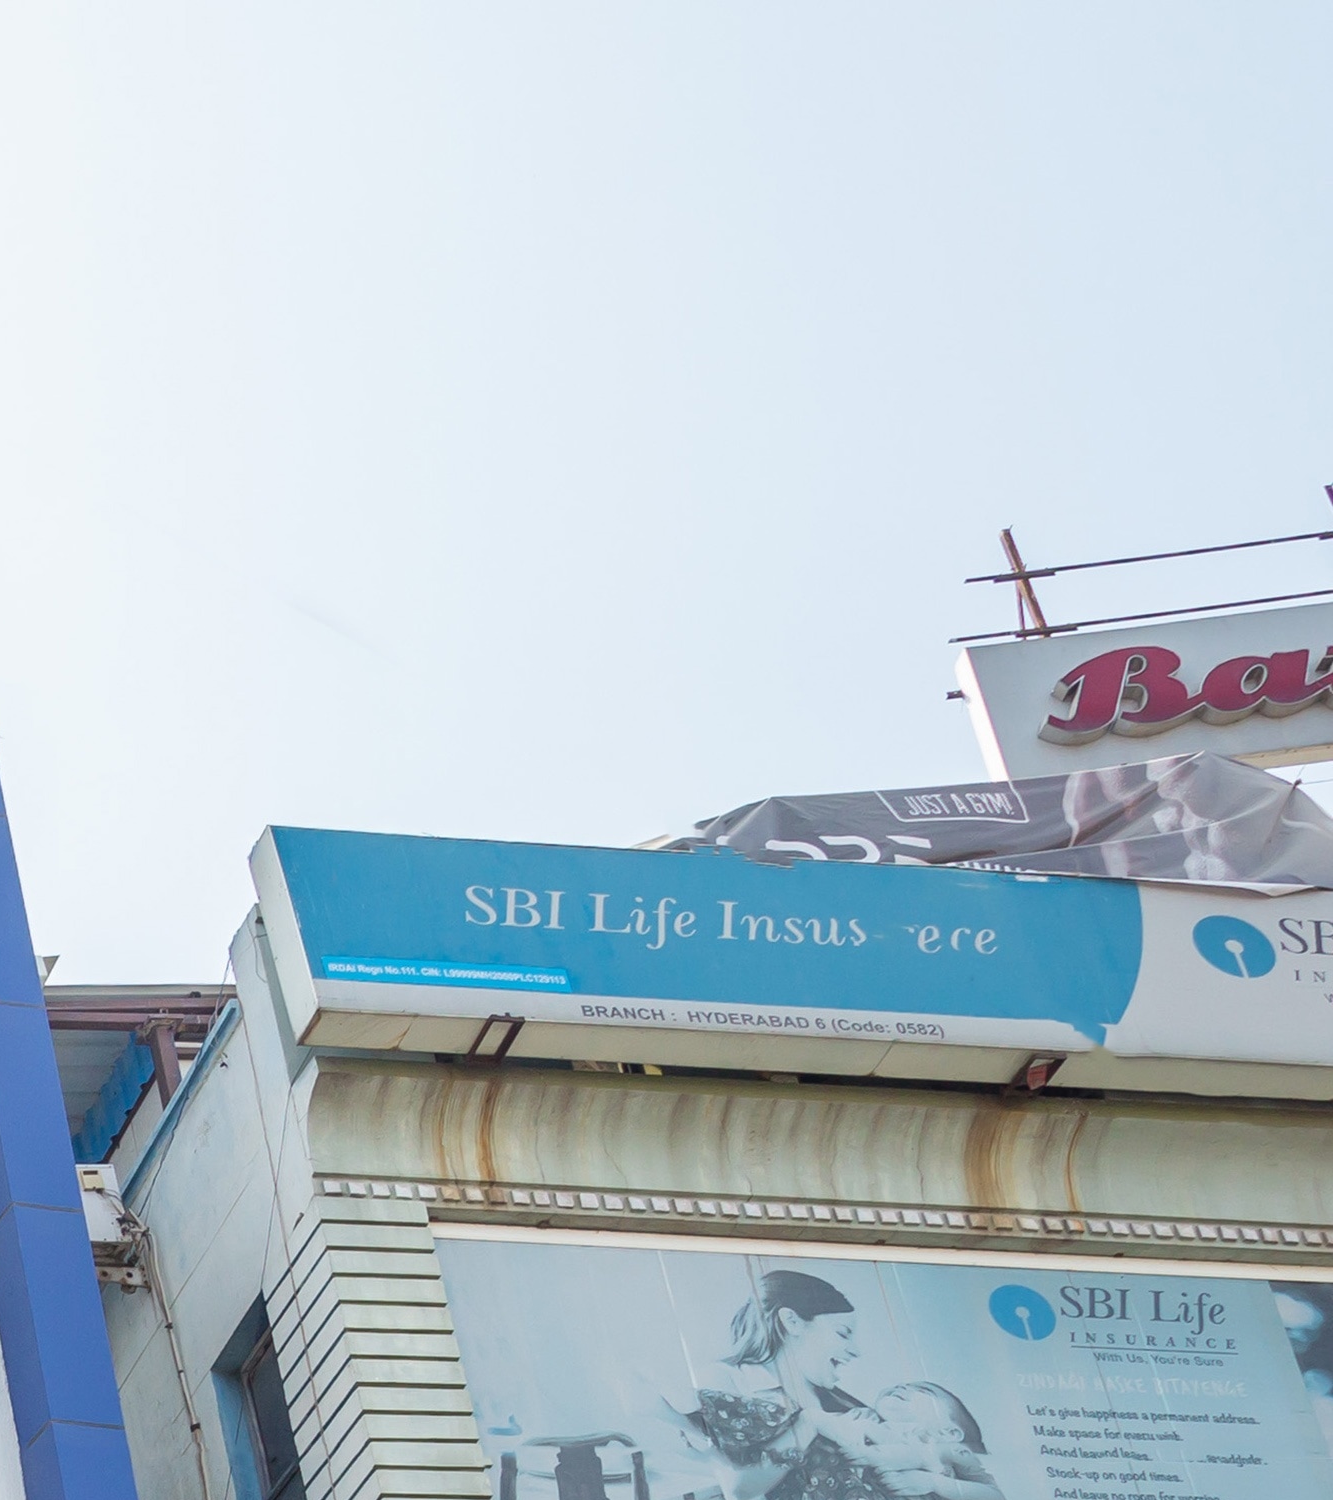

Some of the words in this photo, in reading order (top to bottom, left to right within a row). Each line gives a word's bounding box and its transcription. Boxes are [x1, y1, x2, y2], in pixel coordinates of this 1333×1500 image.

[1038, 645, 1333, 747] Ba
[904, 793, 951, 816] JUST
[950, 793, 971, 814] A
[965, 792, 1015, 816] GYM!
[464, 884, 566, 930] SBI
[588, 892, 697, 951] Life
[357, 964, 383, 976] Regn
[581, 1005, 666, 1022] BRANCH
[687, 1010, 810, 1030] HYDERABAD
[814, 1017, 826, 1030] 6
[832, 1018, 890, 1034] (Code:
[895, 1021, 945, 1040] 0582)
[1058, 1286, 1133, 1321] SBI
[1149, 1290, 1227, 1335] Life
[1070, 1331, 1237, 1350] INSURANCE
[1093, 1351, 1123, 1363] With
[1151, 1354, 1190, 1367] You're
[1195, 1356, 1224, 1367] Sure
[1026, 1404, 1056, 1417] Let's
[1058, 1406, 1081, 1420] give
[1082, 1406, 1139, 1421] happiness
[1141, 1412, 1149, 1421] a
[1151, 1411, 1209, 1424] permanent
[1212, 1412, 1261, 1425] address.
[1033, 1425, 1065, 1438] Make
[1104, 1428, 1121, 1440] for
[1046, 1466, 1100, 1483] Stock-up
[1102, 1471, 1117, 1482] on
[1119, 1470, 1147, 1484] good
[1054, 1487, 1078, 1499] And
[1078, 1488, 1109, 1500] leave
